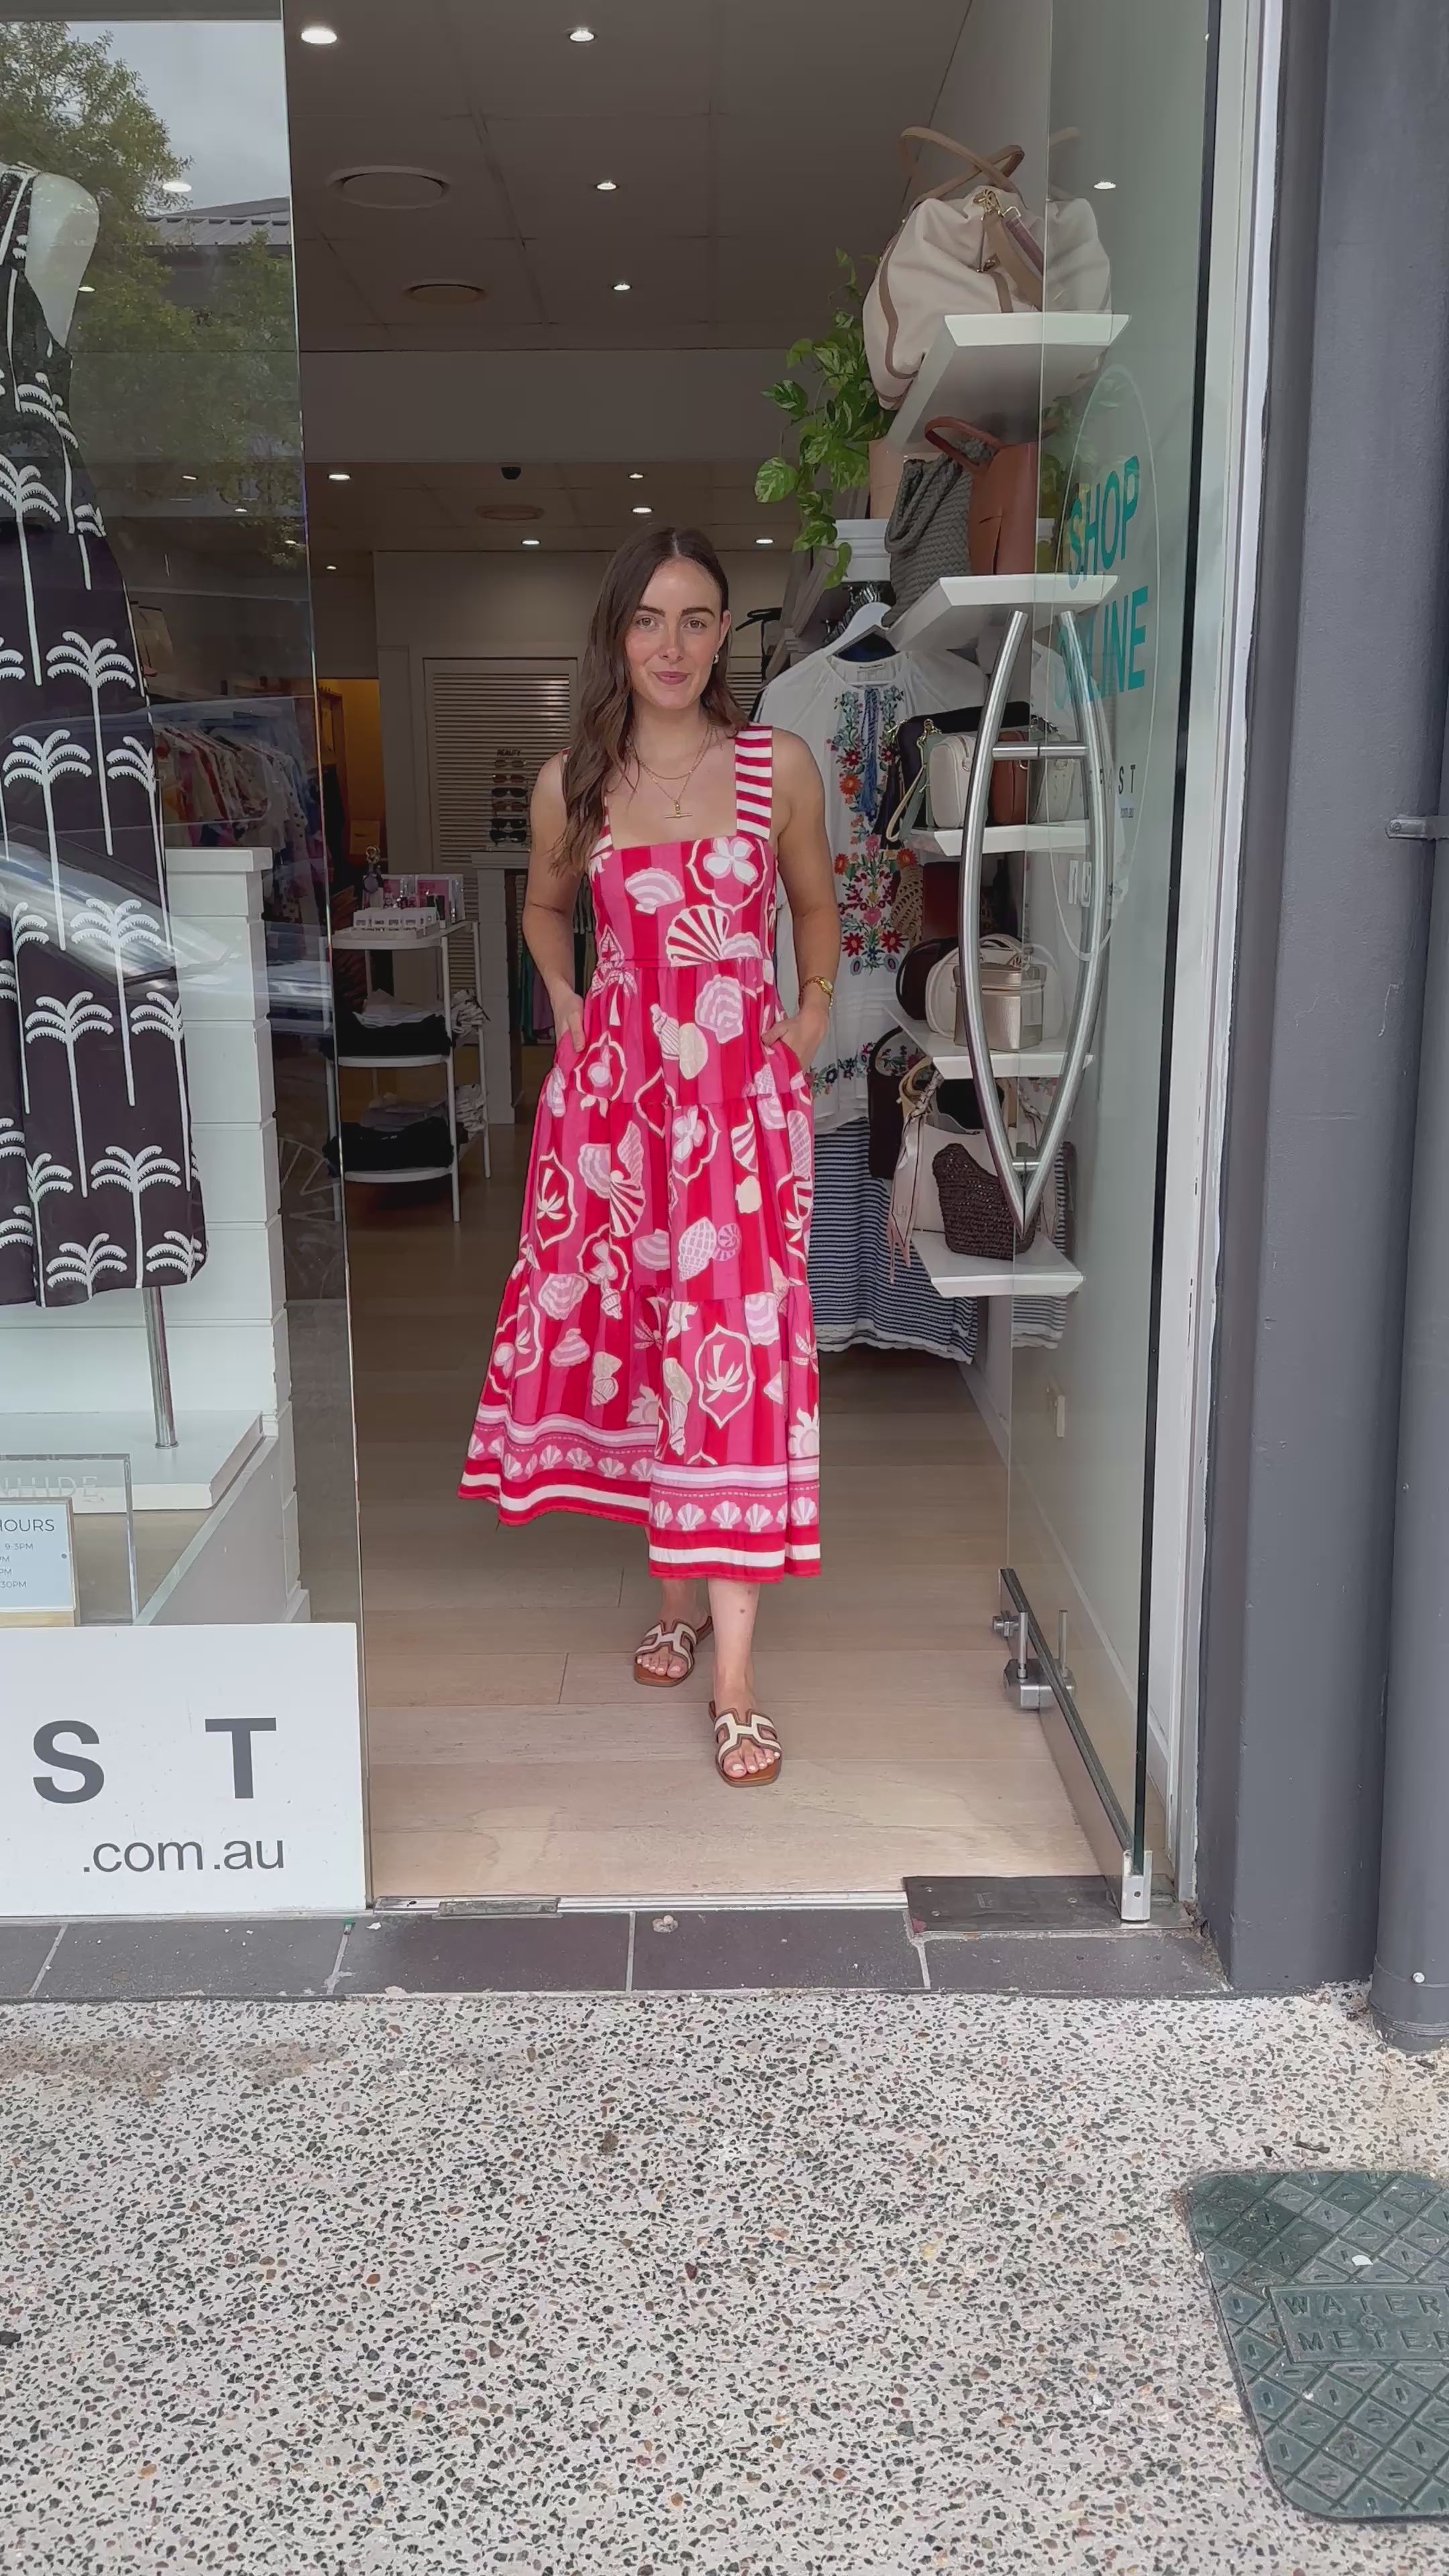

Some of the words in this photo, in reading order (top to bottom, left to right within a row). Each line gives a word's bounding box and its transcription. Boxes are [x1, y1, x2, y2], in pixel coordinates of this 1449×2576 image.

[1067, 455, 1140, 590] SHOP
[0, 1519, 55, 1532] OURS
[83, 1839, 284, 1872] .com.au
[1282, 2294, 1442, 2316] WATER
